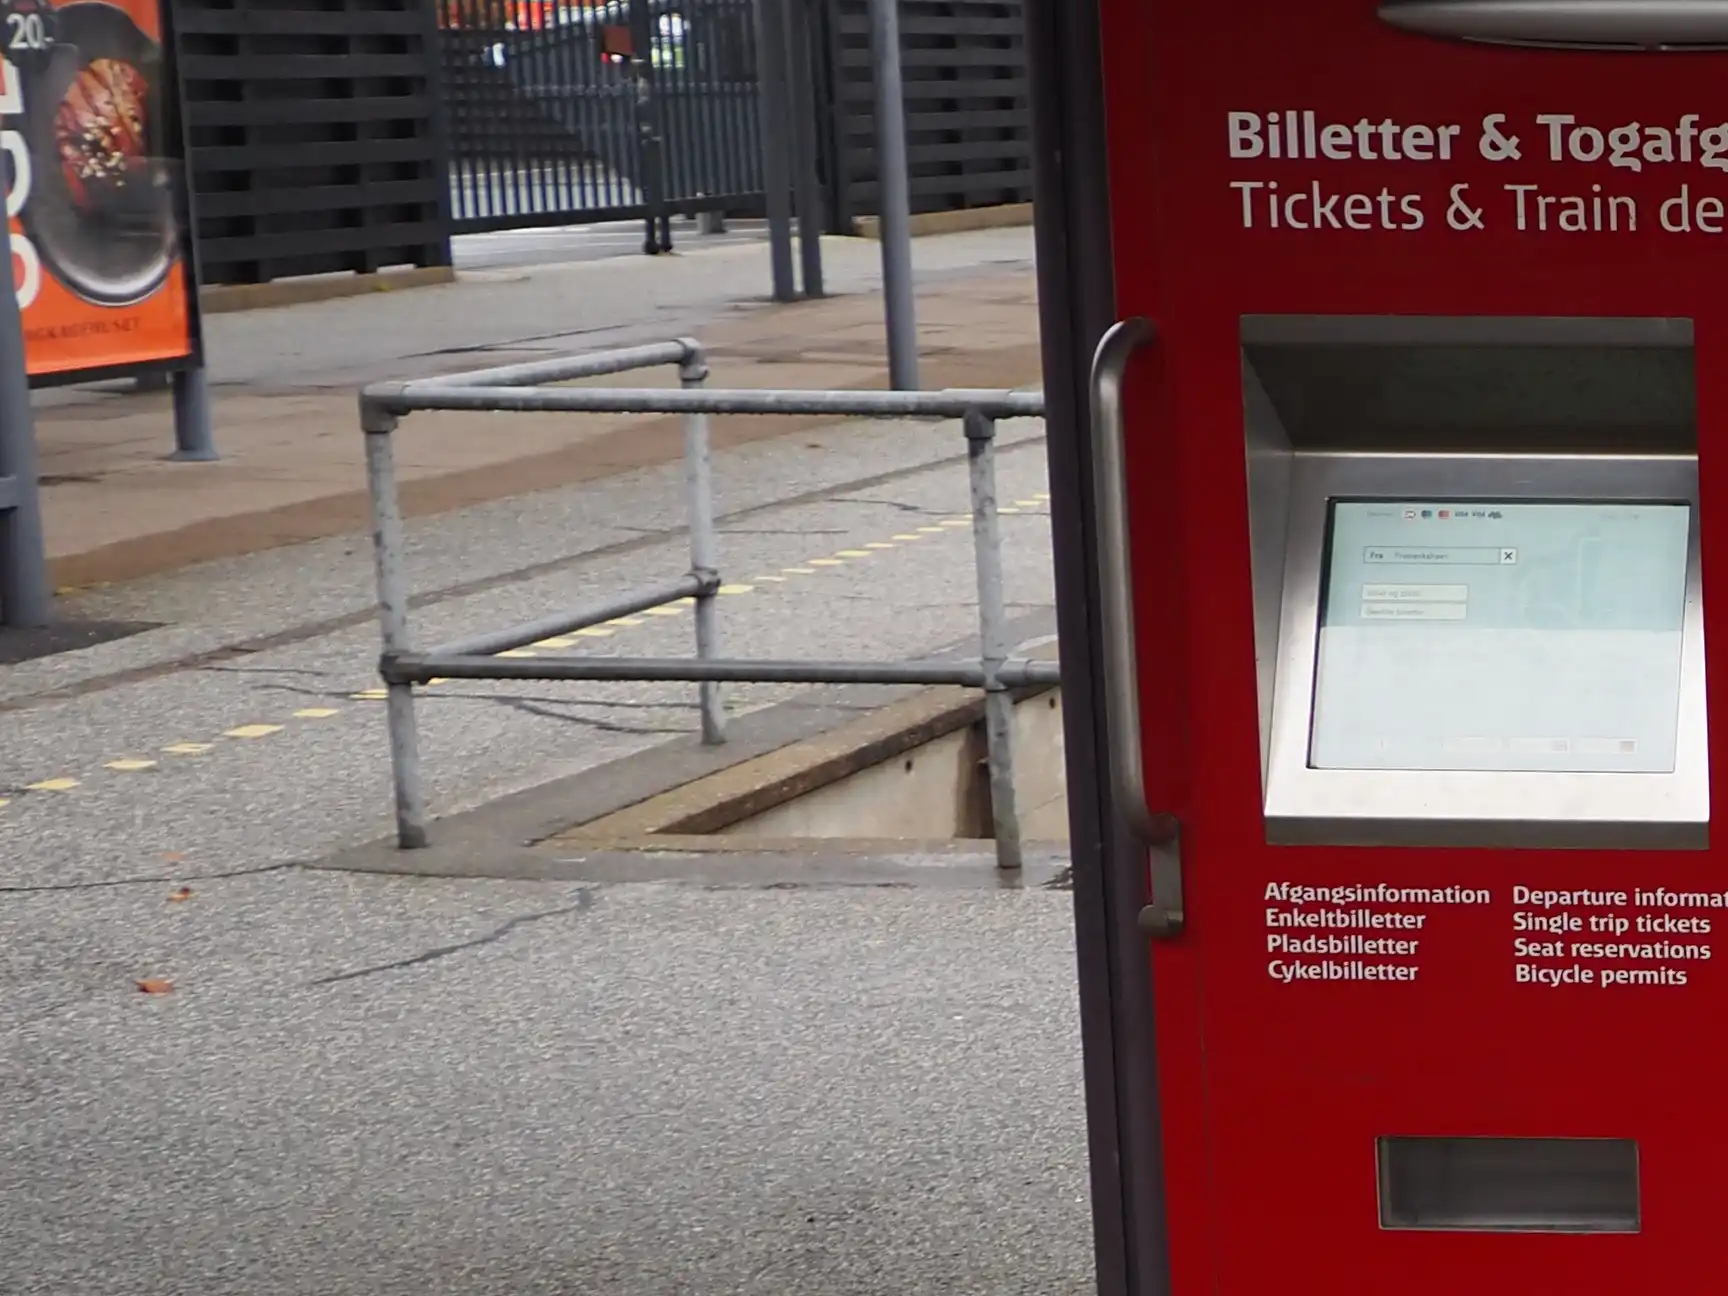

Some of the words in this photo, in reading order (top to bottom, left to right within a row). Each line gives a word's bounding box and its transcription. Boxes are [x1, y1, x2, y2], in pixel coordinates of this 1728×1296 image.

[1229, 111, 1460, 160] Billetter
[1479, 114, 1521, 160] &
[1230, 181, 1423, 229] Tickets
[1447, 183, 1484, 230] &
[1504, 184, 1636, 231] Train
[1264, 882, 1490, 906] Afgangsinformation
[1513, 886, 1628, 911] Departure
[1265, 908, 1427, 929] Enkeltbilletter
[1513, 912, 1583, 938] Single
[1588, 913, 1630, 937] trip
[1635, 913, 1712, 935] tickets
[1266, 933, 1419, 955] Pladsbilletter
[1514, 938, 1565, 959] Seat
[1571, 940, 1712, 960] reservations
[1267, 959, 1419, 984] Cykelbilletter
[1515, 964, 1594, 989] Bicycle
[1600, 965, 1688, 989] permits
